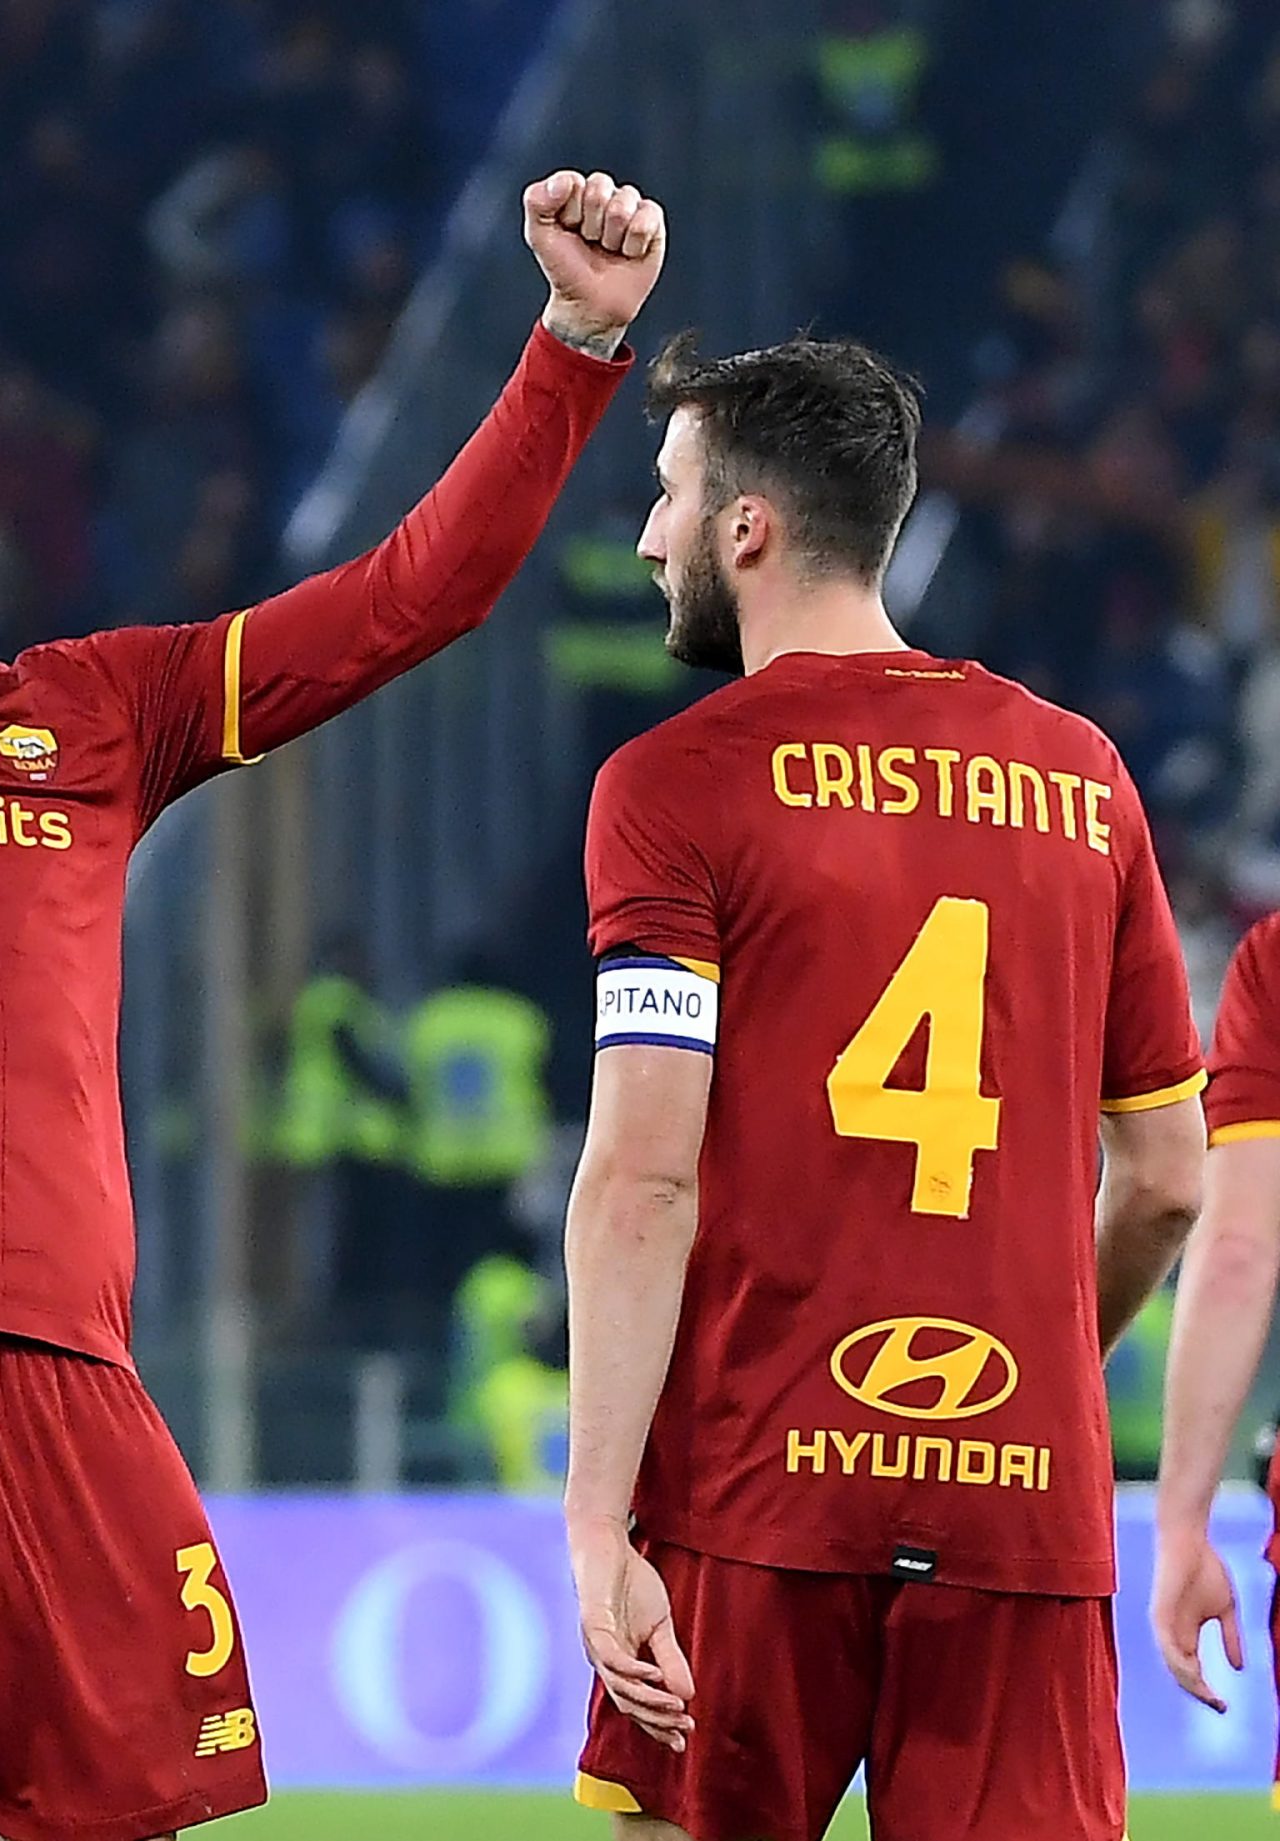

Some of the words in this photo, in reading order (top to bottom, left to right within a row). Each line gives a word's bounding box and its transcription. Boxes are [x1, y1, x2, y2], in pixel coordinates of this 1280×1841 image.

[771, 742, 1112, 857] CRISTANTE
[826, 895, 1002, 1220] 4
[786, 1429, 1051, 1492] HYUNDAI
[175, 1542, 234, 1677] 3
